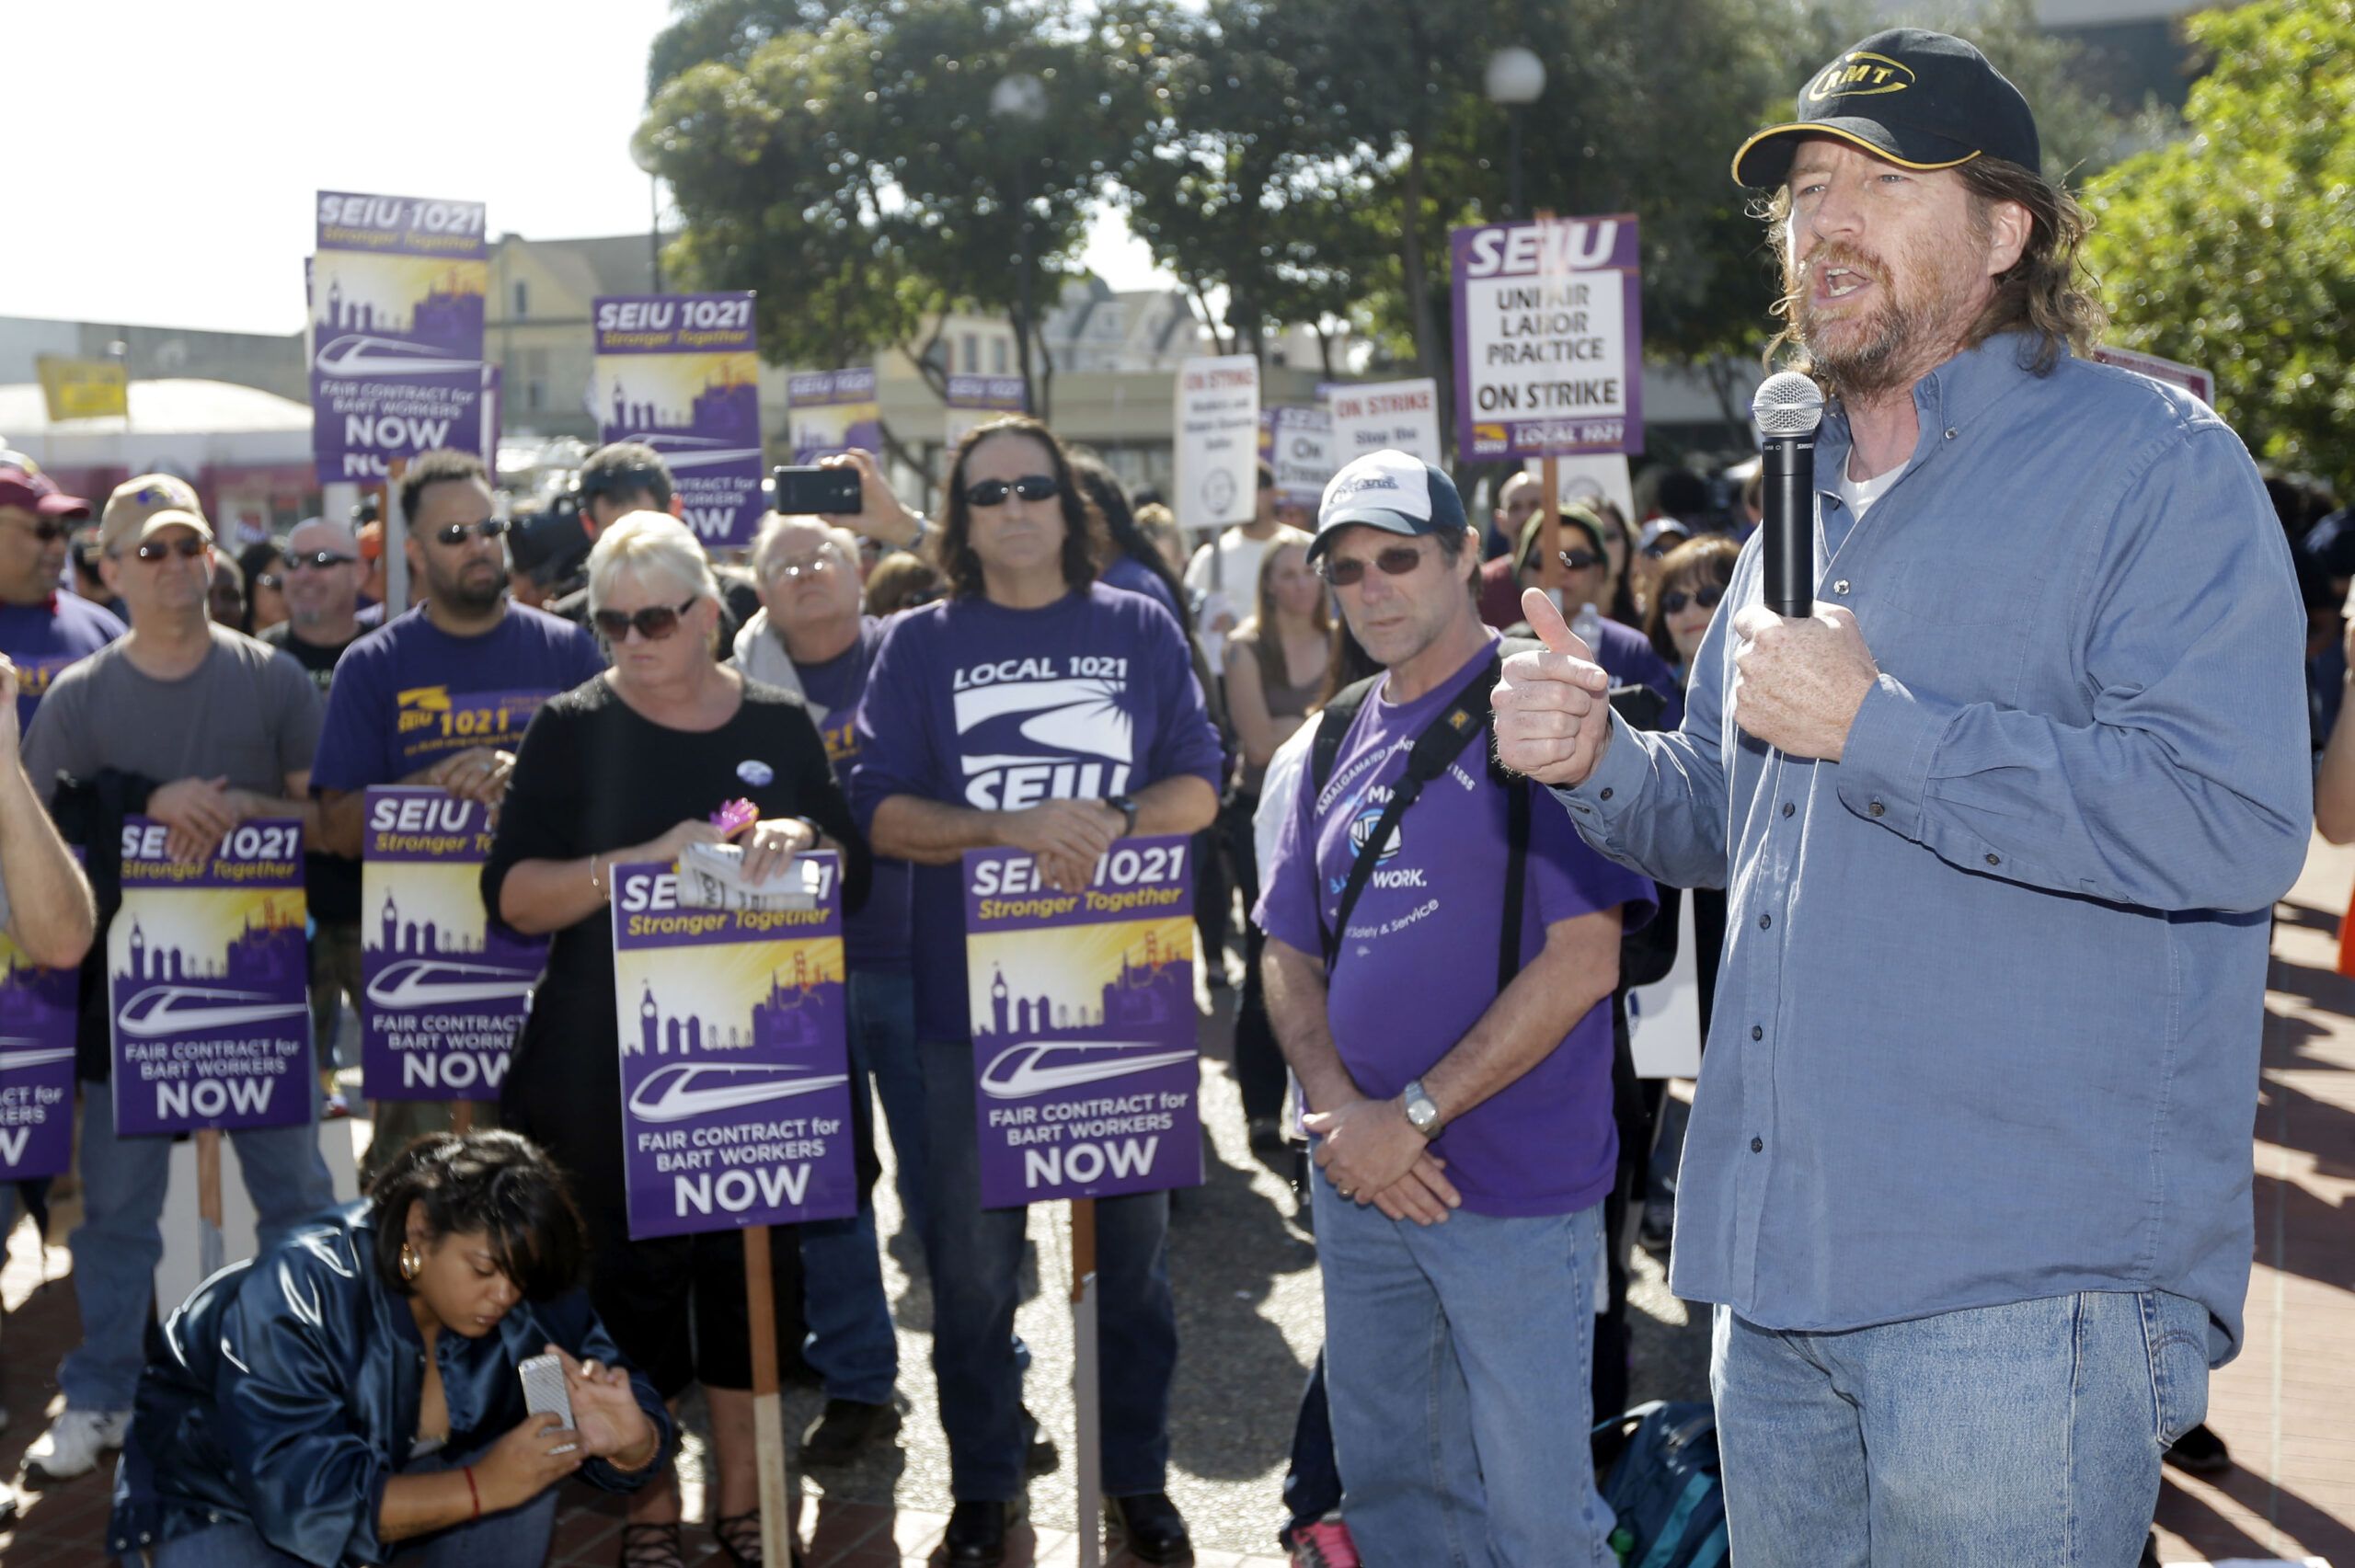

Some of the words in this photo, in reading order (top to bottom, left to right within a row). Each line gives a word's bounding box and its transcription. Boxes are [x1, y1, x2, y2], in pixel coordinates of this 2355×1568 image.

[319, 195, 402, 229] SEIU
[412, 201, 484, 235] 1021
[324, 225, 398, 246] Stronger
[405, 231, 480, 251] Together
[1467, 221, 1618, 276] SEIU
[598, 302, 674, 330] SEIU
[682, 300, 752, 328] 1021
[603, 330, 672, 349] Stronger
[678, 329, 748, 347] Together
[1487, 338, 1604, 365] PRACTICE
[320, 381, 357, 396] FAIR
[361, 383, 449, 401] CONTRACT
[452, 388, 475, 405] for
[791, 378, 833, 394] SEIU
[835, 374, 871, 390] 1021
[1478, 383, 1517, 410] ON
[1526, 379, 1619, 408] STRIKE
[333, 396, 377, 413] BART
[381, 401, 462, 419] WORKERS
[1337, 398, 1361, 418] ON
[1368, 392, 1430, 417] STRIKE
[346, 415, 450, 450] NOW
[1513, 426, 1577, 444] LOCAL
[1580, 424, 1625, 442] 1021
[684, 492, 746, 508] ORKERS
[953, 658, 1057, 690] LOCAL
[1069, 657, 1128, 679] 1021
[440, 707, 511, 737] 1021
[966, 763, 1131, 811] SEIU
[370, 797, 474, 832] SEIU
[121, 824, 167, 860] SE
[220, 826, 299, 860] 1021
[375, 831, 467, 856] Stronger
[121, 859, 206, 882] Stronger
[213, 858, 296, 882] Together
[971, 856, 1041, 897] SEI
[1094, 845, 1185, 887] 1021
[1372, 868, 1428, 889] WORK.
[621, 874, 678, 911] SE
[979, 896, 1079, 920] Stronger
[1085, 886, 1183, 912] Together
[628, 911, 727, 936] Stronger
[736, 907, 831, 931] Together
[1391, 898, 1439, 933] Service
[373, 1014, 418, 1033] FAIR
[421, 1013, 525, 1033] CONTRACT
[125, 1042, 168, 1062] FAIR
[172, 1038, 271, 1060] CONTRACT
[275, 1037, 300, 1056] for
[388, 1032, 441, 1050] BART
[446, 1032, 515, 1050] WORKE
[141, 1060, 191, 1081] BART
[196, 1057, 287, 1077] WORKERS
[403, 1051, 511, 1089] NOW
[156, 1077, 274, 1120] NOW
[989, 1105, 1038, 1127] FAIR
[1041, 1093, 1155, 1122] CONTRACT
[1159, 1092, 1189, 1110] for
[638, 1130, 688, 1152] FAIR
[692, 1118, 808, 1148] CONTRACT
[811, 1116, 841, 1137] for
[1006, 1125, 1063, 1147] BART
[1068, 1113, 1174, 1140] WORKERS
[656, 1150, 715, 1173] BART
[718, 1139, 826, 1166] WORKERS
[1025, 1136, 1159, 1189] NOW
[674, 1162, 812, 1218] NOW
